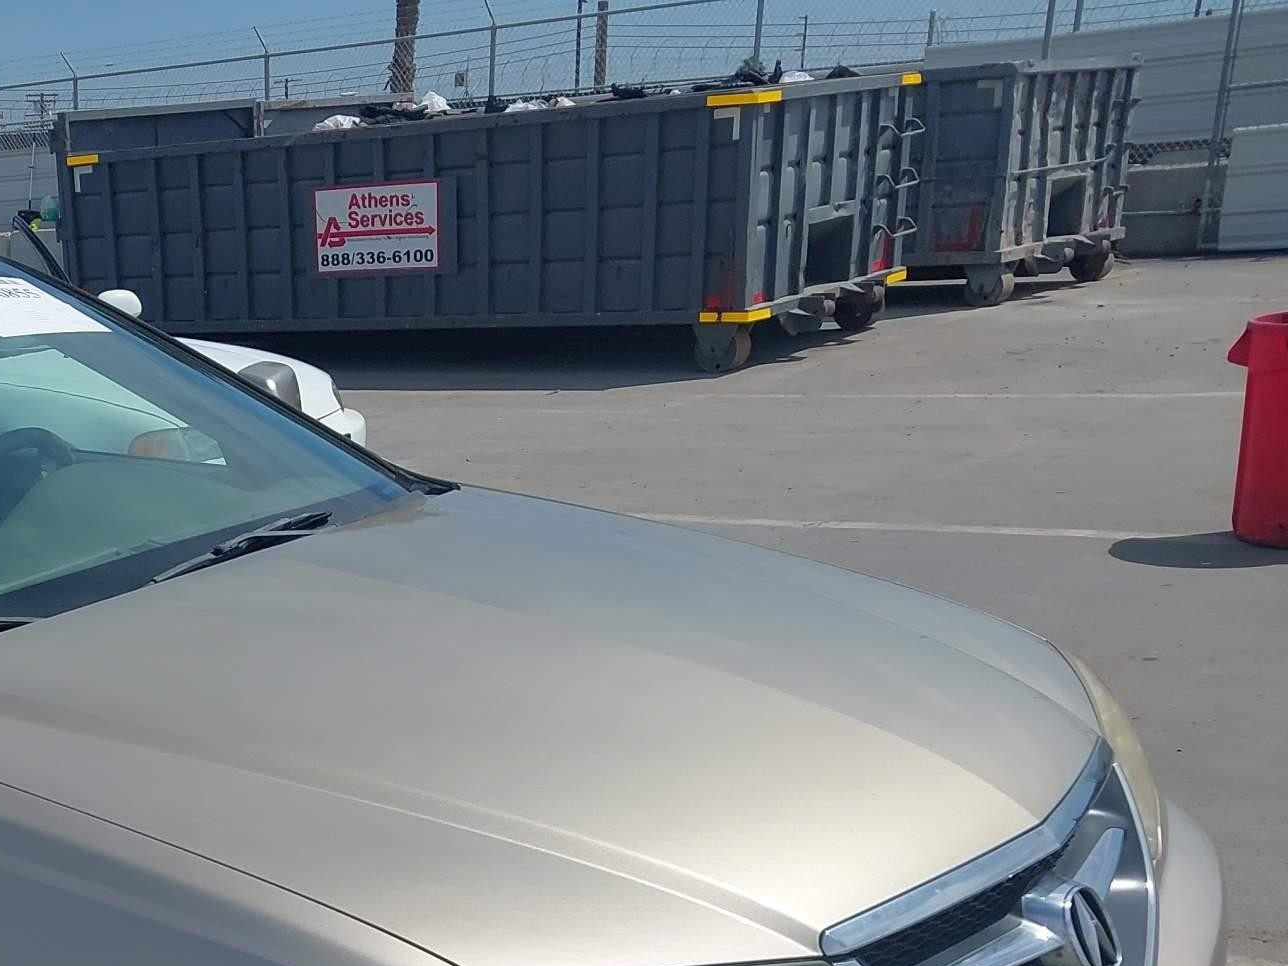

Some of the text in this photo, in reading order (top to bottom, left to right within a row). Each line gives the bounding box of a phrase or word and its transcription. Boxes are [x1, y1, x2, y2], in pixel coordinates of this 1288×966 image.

[348, 192, 411, 210] Athens
[348, 209, 425, 229] Services
[320, 249, 435, 268] 888/336-6100
